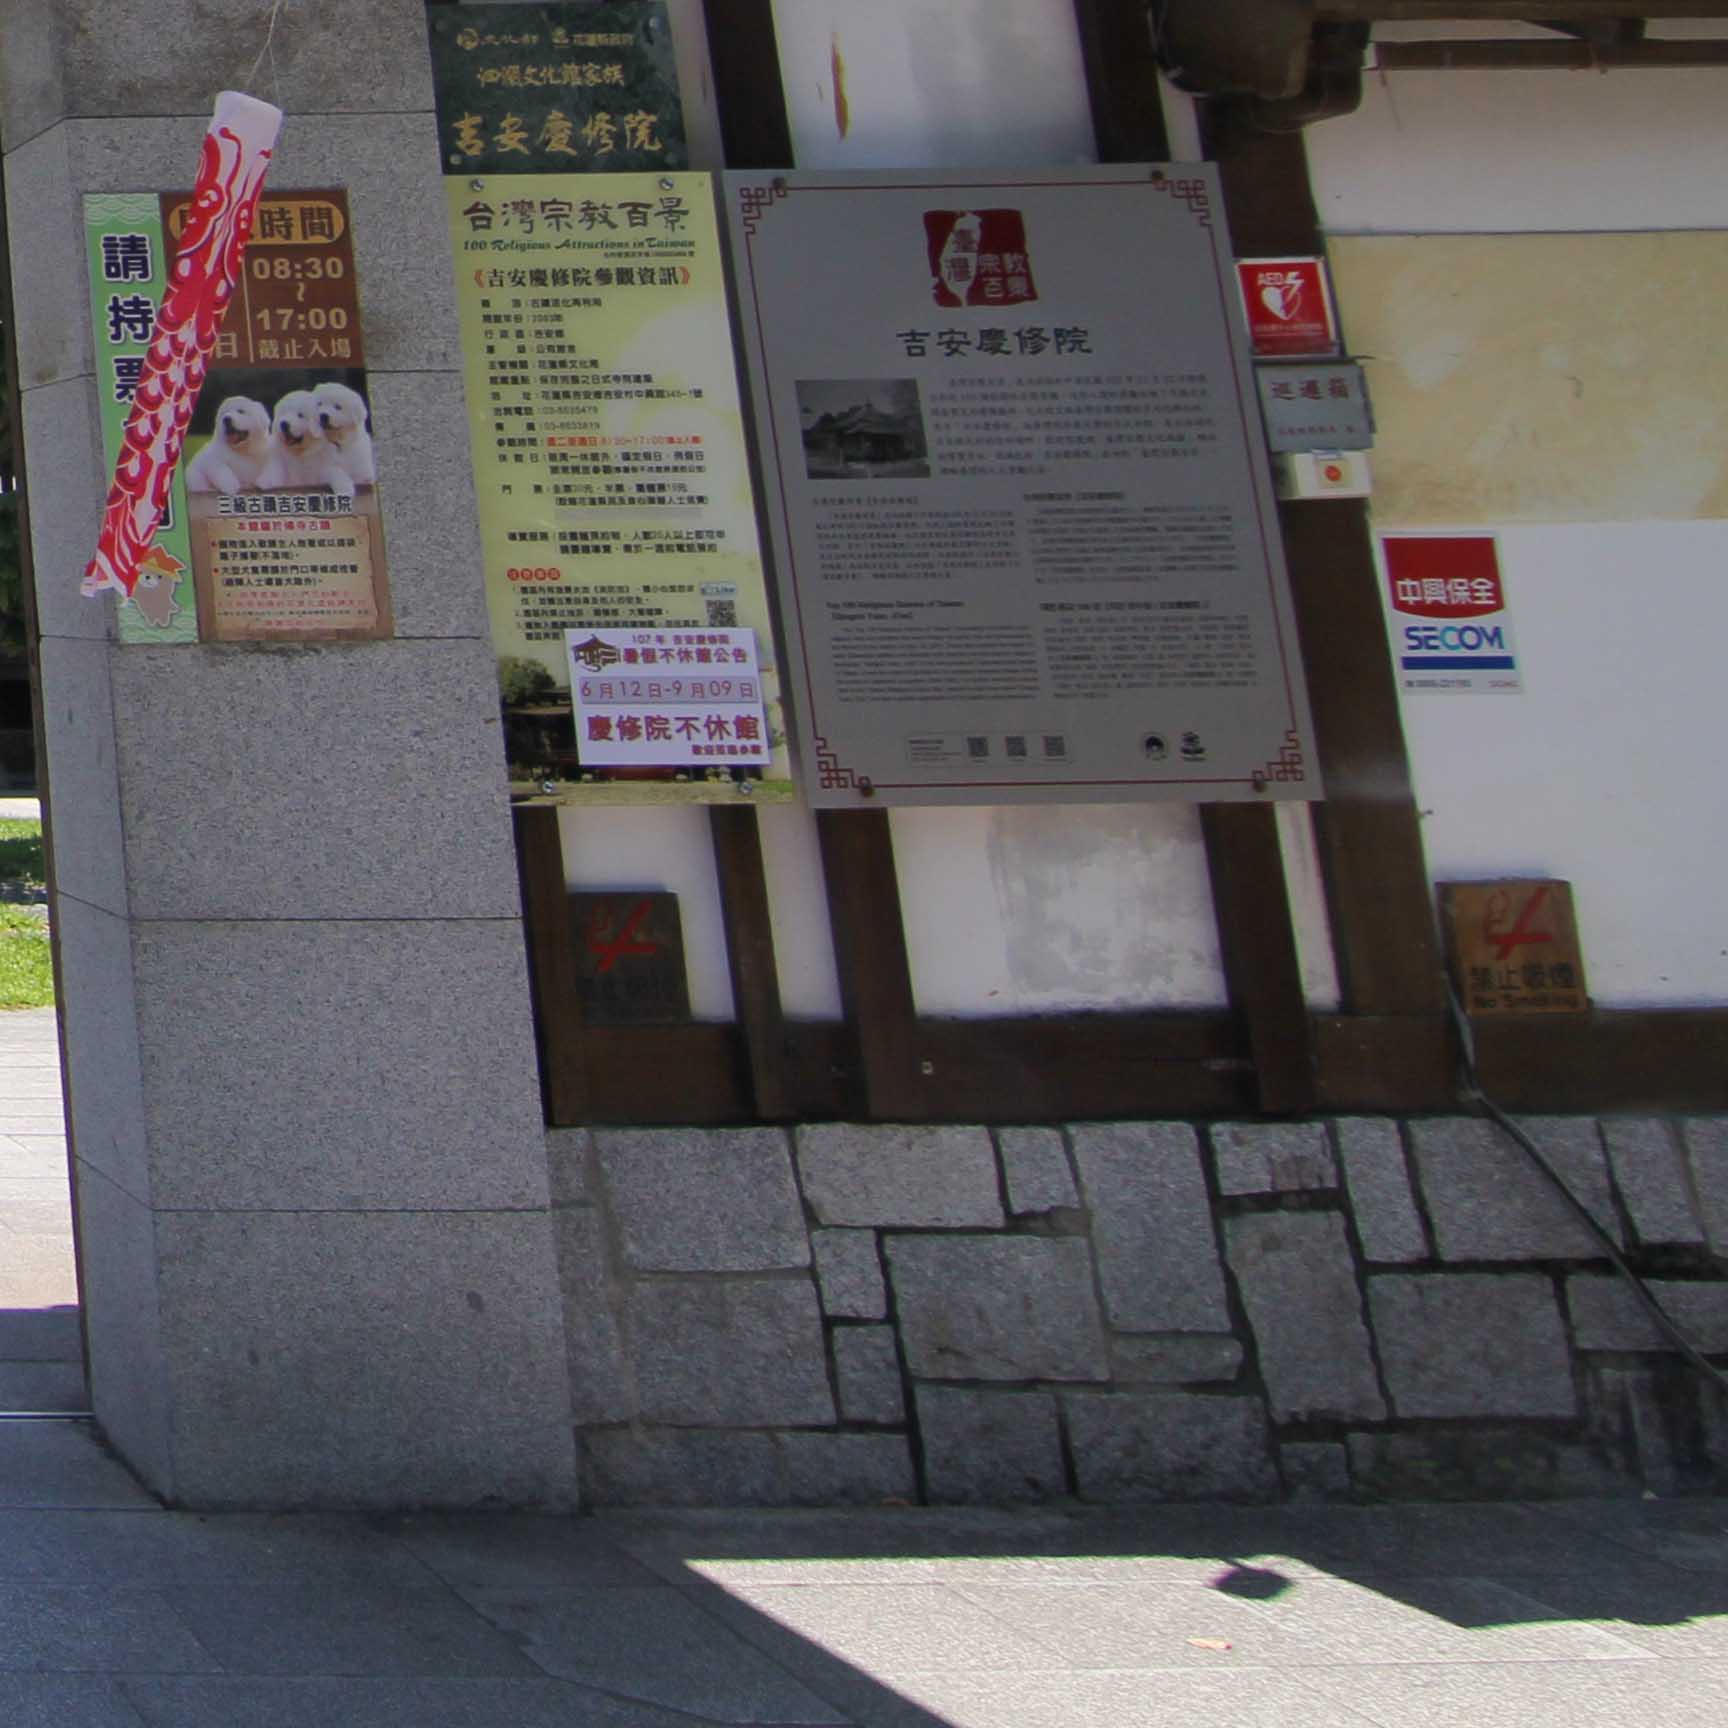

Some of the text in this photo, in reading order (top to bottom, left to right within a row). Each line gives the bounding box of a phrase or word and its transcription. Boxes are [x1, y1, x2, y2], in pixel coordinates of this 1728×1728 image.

[451, 109, 663, 157] 吉安慶修院
[463, 197, 690, 234] 台灣宗教百景
[463, 240, 488, 252] 100
[490, 238, 552, 254] Religious
[554, 237, 630, 251] Attractions
[645, 237, 696, 250] Taiwan
[252, 256, 344, 280] 08:30
[256, 308, 348, 330] 17:00
[258, 338, 352, 361] 截止入場
[896, 327, 1094, 359] 吉安慶修院
[217, 495, 352, 513] 三級古蹟吉安慶修院
[1395, 577, 1496, 605] 中興保全
[1403, 625, 1505, 651] SECOM
[623, 647, 748, 665] 暑假不休館公告
[586, 714, 761, 743] 慶修院不休館
